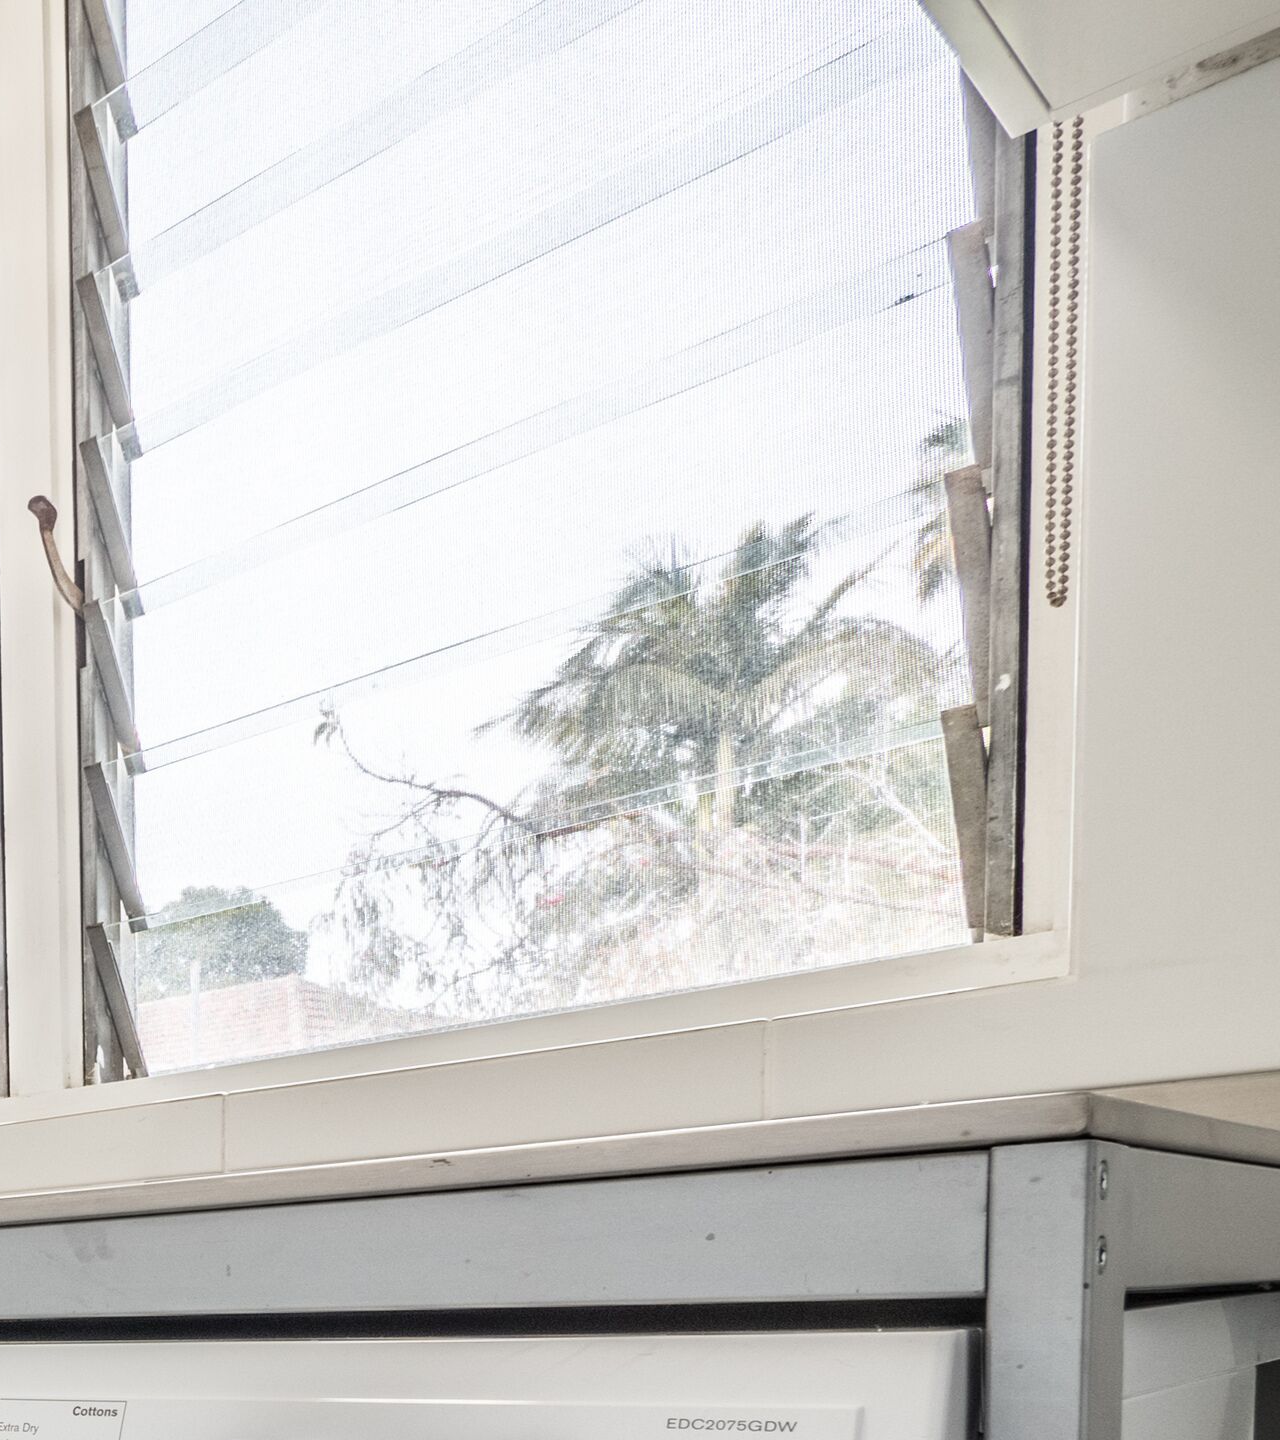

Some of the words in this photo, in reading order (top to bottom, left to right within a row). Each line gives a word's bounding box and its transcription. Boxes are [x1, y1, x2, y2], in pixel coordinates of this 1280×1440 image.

[72, 1406, 118, 1417] Cottons
[22, 1422, 39, 1435] Dry
[666, 1418, 798, 1433] EDC2075GDW
